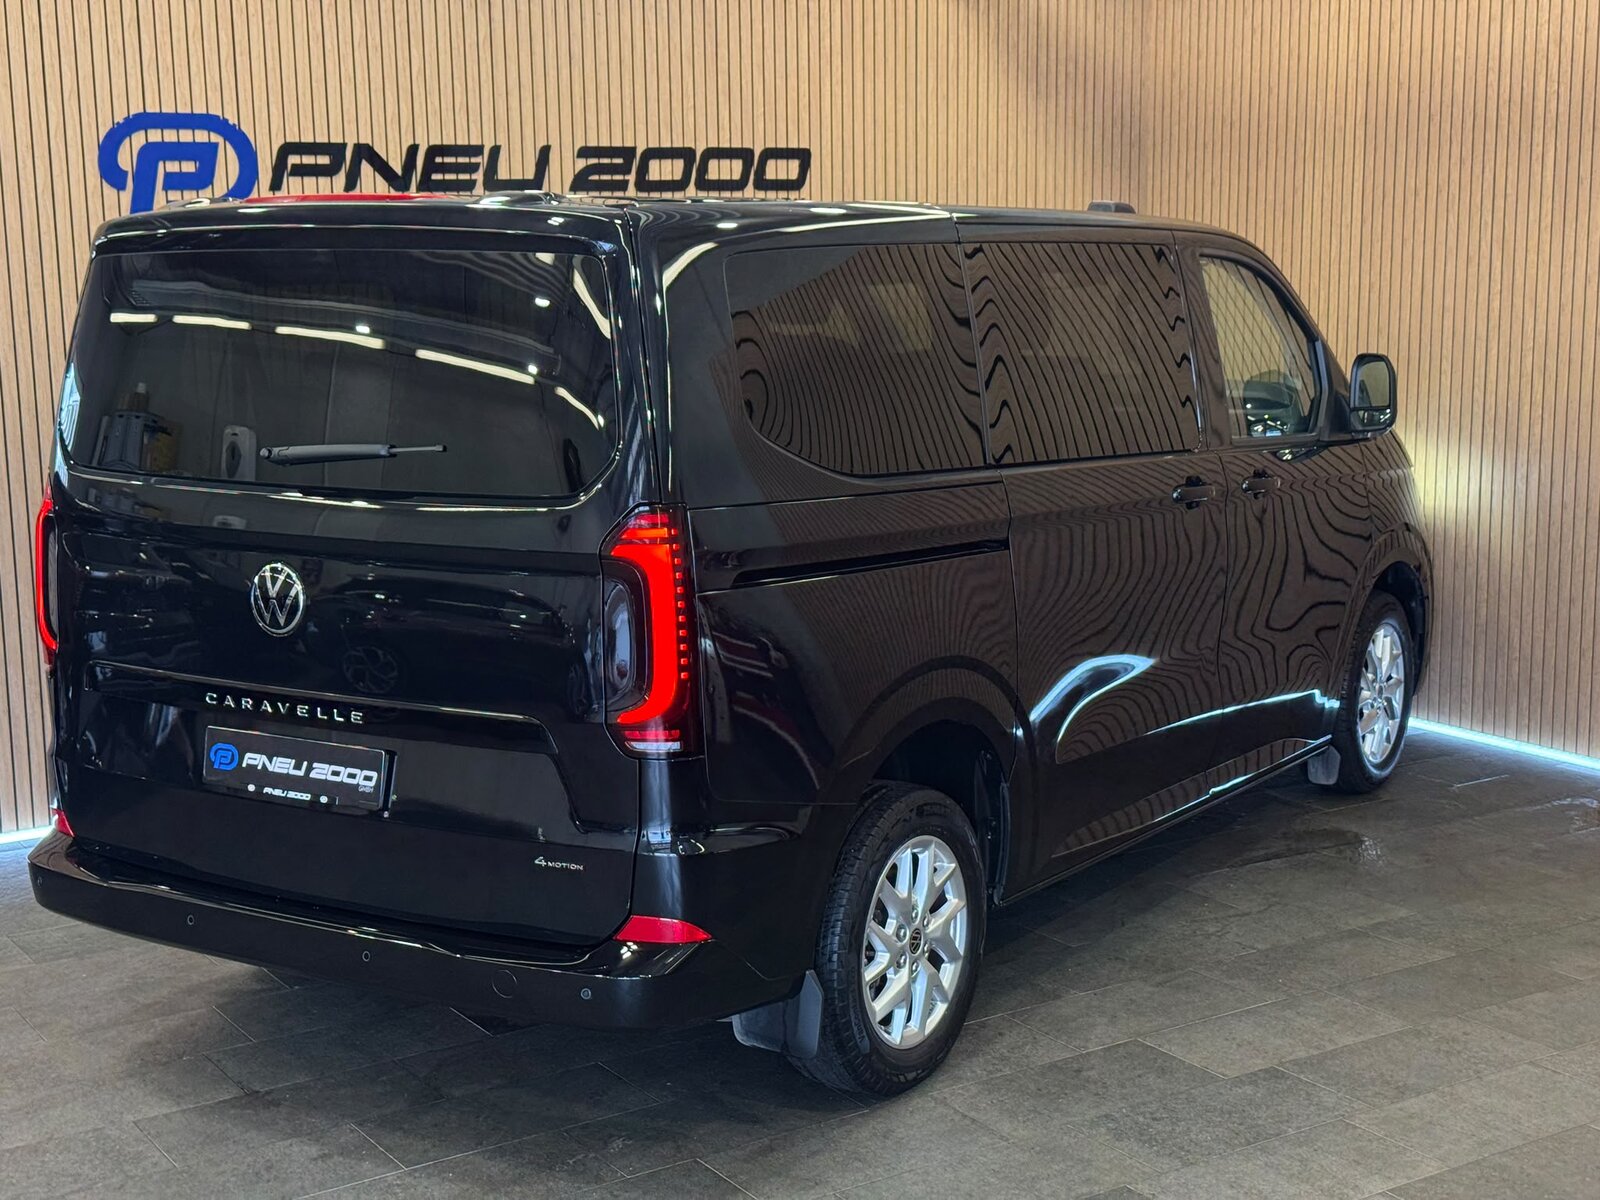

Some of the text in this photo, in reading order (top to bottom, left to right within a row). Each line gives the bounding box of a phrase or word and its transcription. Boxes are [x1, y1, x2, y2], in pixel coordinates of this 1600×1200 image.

[268, 142, 551, 193] PNEU
[570, 146, 812, 193] 2000
[205, 692, 364, 724] CARAVELLE
[241, 752, 308, 777] PNEU
[309, 762, 378, 787] 2000
[263, 786, 312, 801] PNEU 2000
